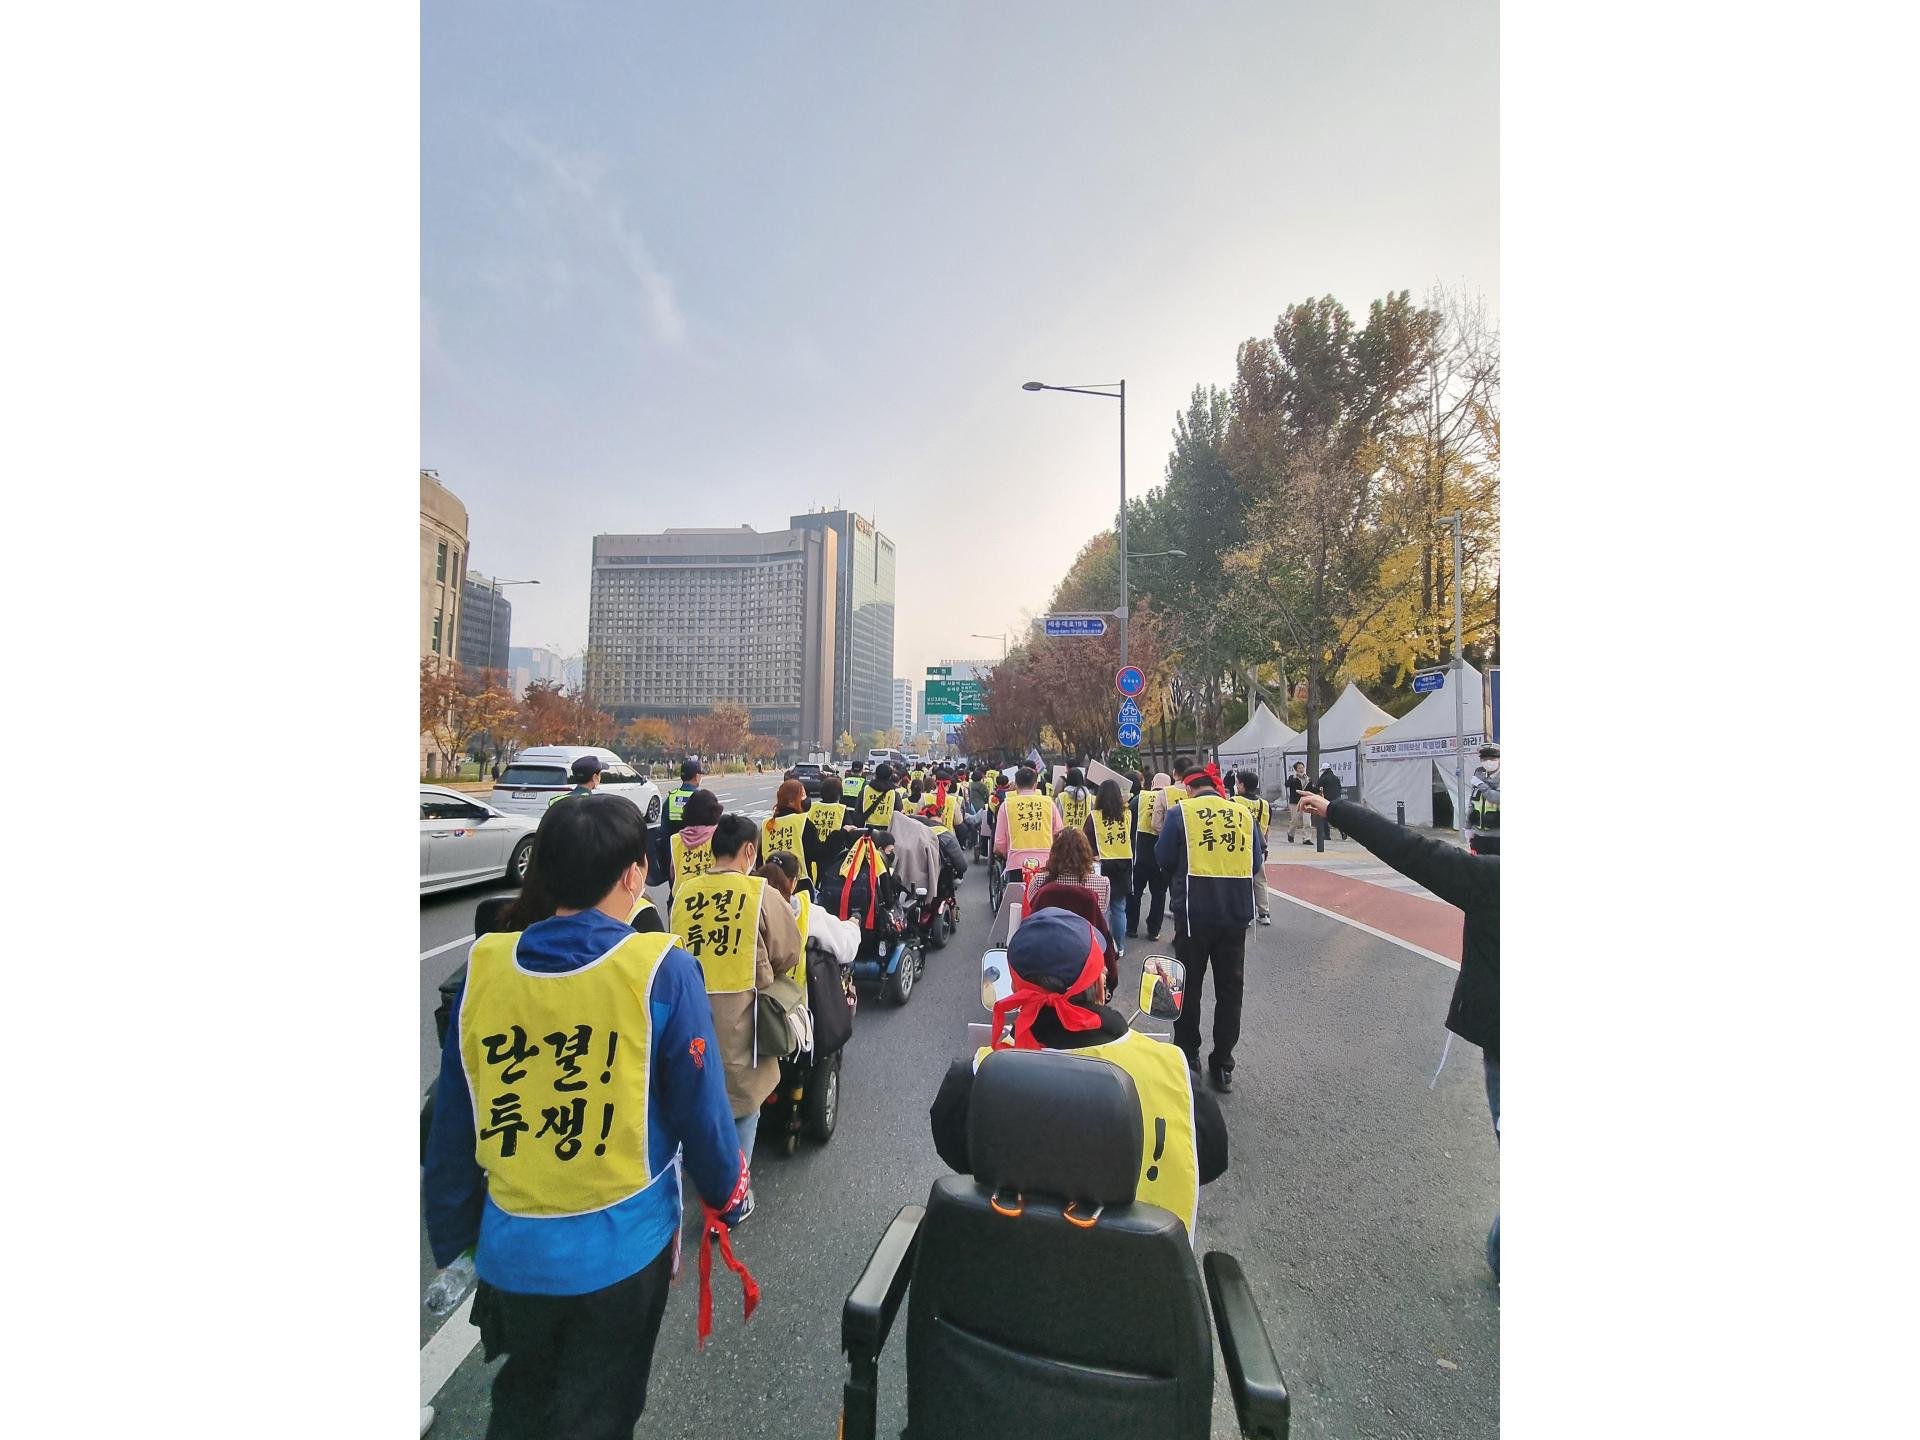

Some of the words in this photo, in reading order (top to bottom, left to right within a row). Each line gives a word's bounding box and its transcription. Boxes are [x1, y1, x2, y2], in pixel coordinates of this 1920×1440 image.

[1017, 802, 1042, 811] 장애인
[814, 809, 836, 820] 장애인
[1017, 811, 1043, 821] 노동권
[1196, 807, 1242, 828] 단결!
[813, 819, 834, 829] 노동권
[1021, 821, 1042, 832] 쟁취!
[769, 825, 793, 840] 장애인
[768, 839, 793, 852] 노동권
[1198, 828, 1246, 853] 투쟁!
[682, 849, 713, 862] 장애인
[685, 889, 746, 922] 단결!
[686, 924, 741, 956] 투쟁!
[481, 1024, 618, 1092] 단결!
[480, 1092, 614, 1161] 투쟁!
